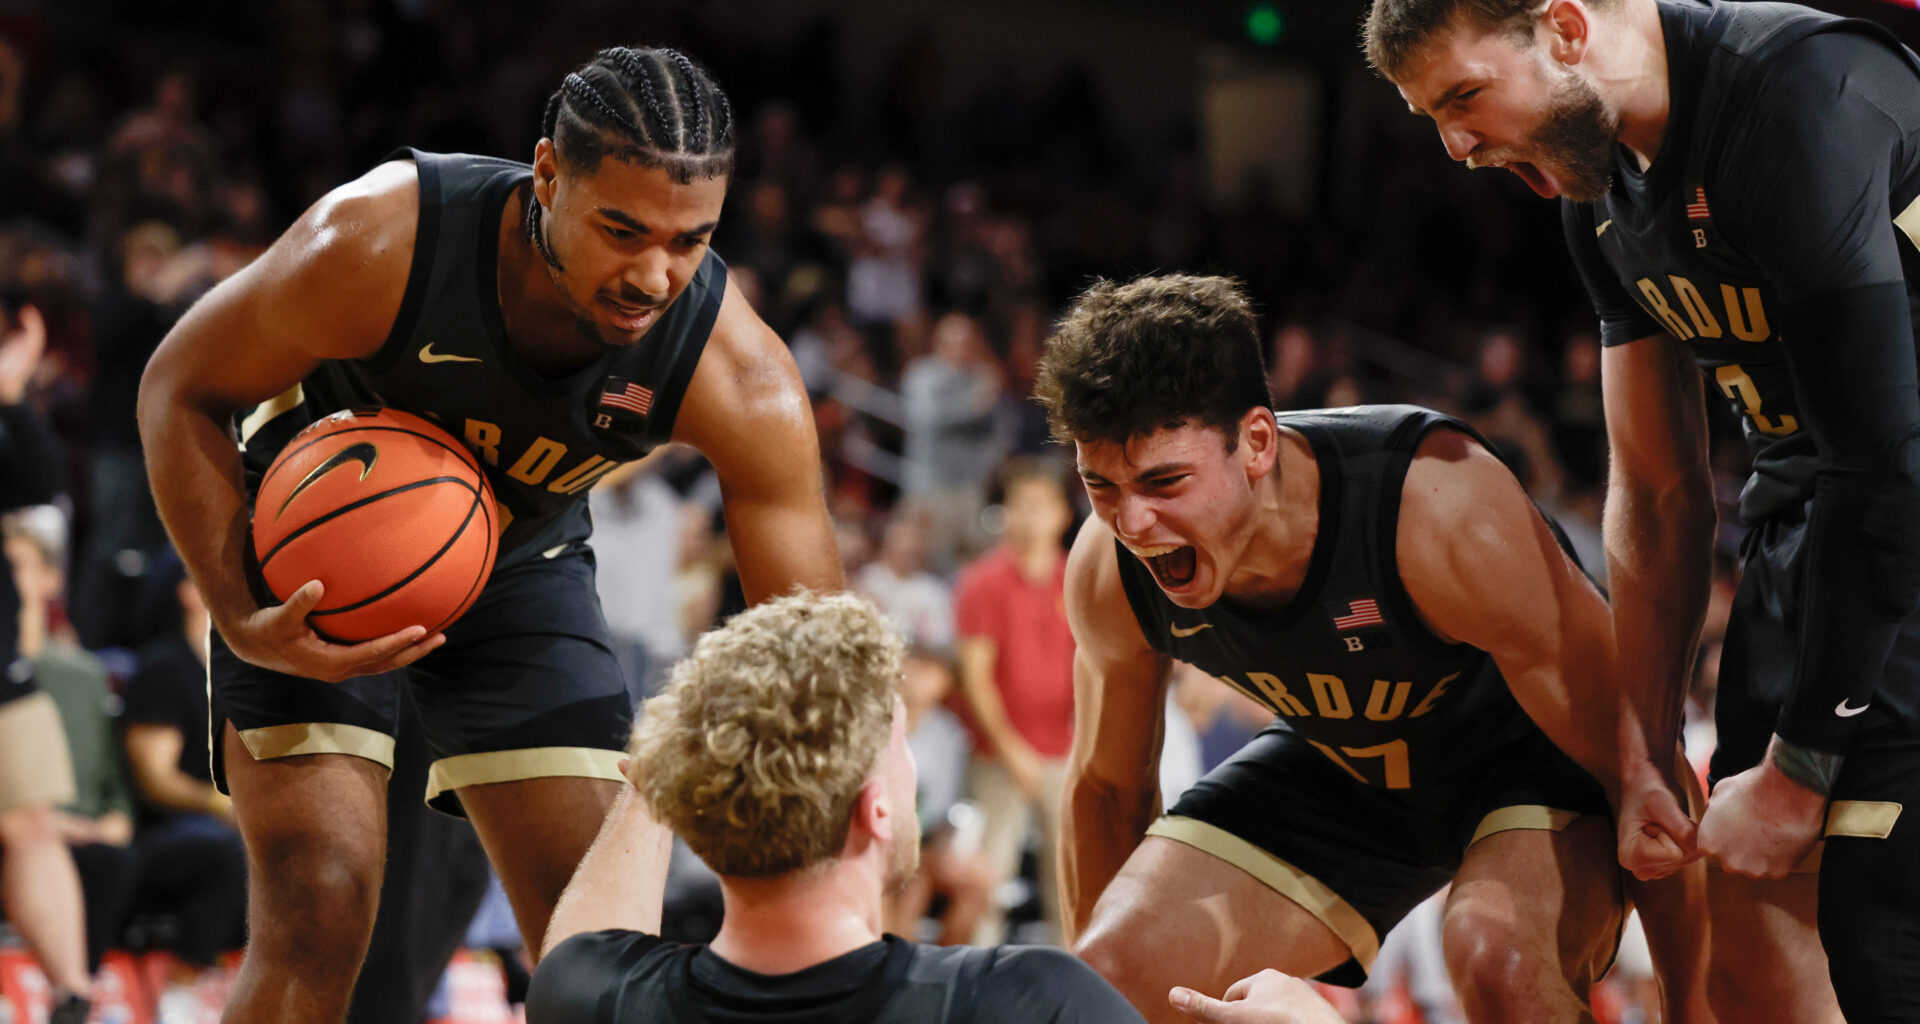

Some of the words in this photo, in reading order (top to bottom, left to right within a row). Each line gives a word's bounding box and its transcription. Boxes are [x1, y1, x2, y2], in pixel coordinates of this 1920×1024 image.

[1635, 274, 1771, 342] RDU
[424, 411, 619, 495] RDU
[1218, 672, 1461, 721] RDUE
